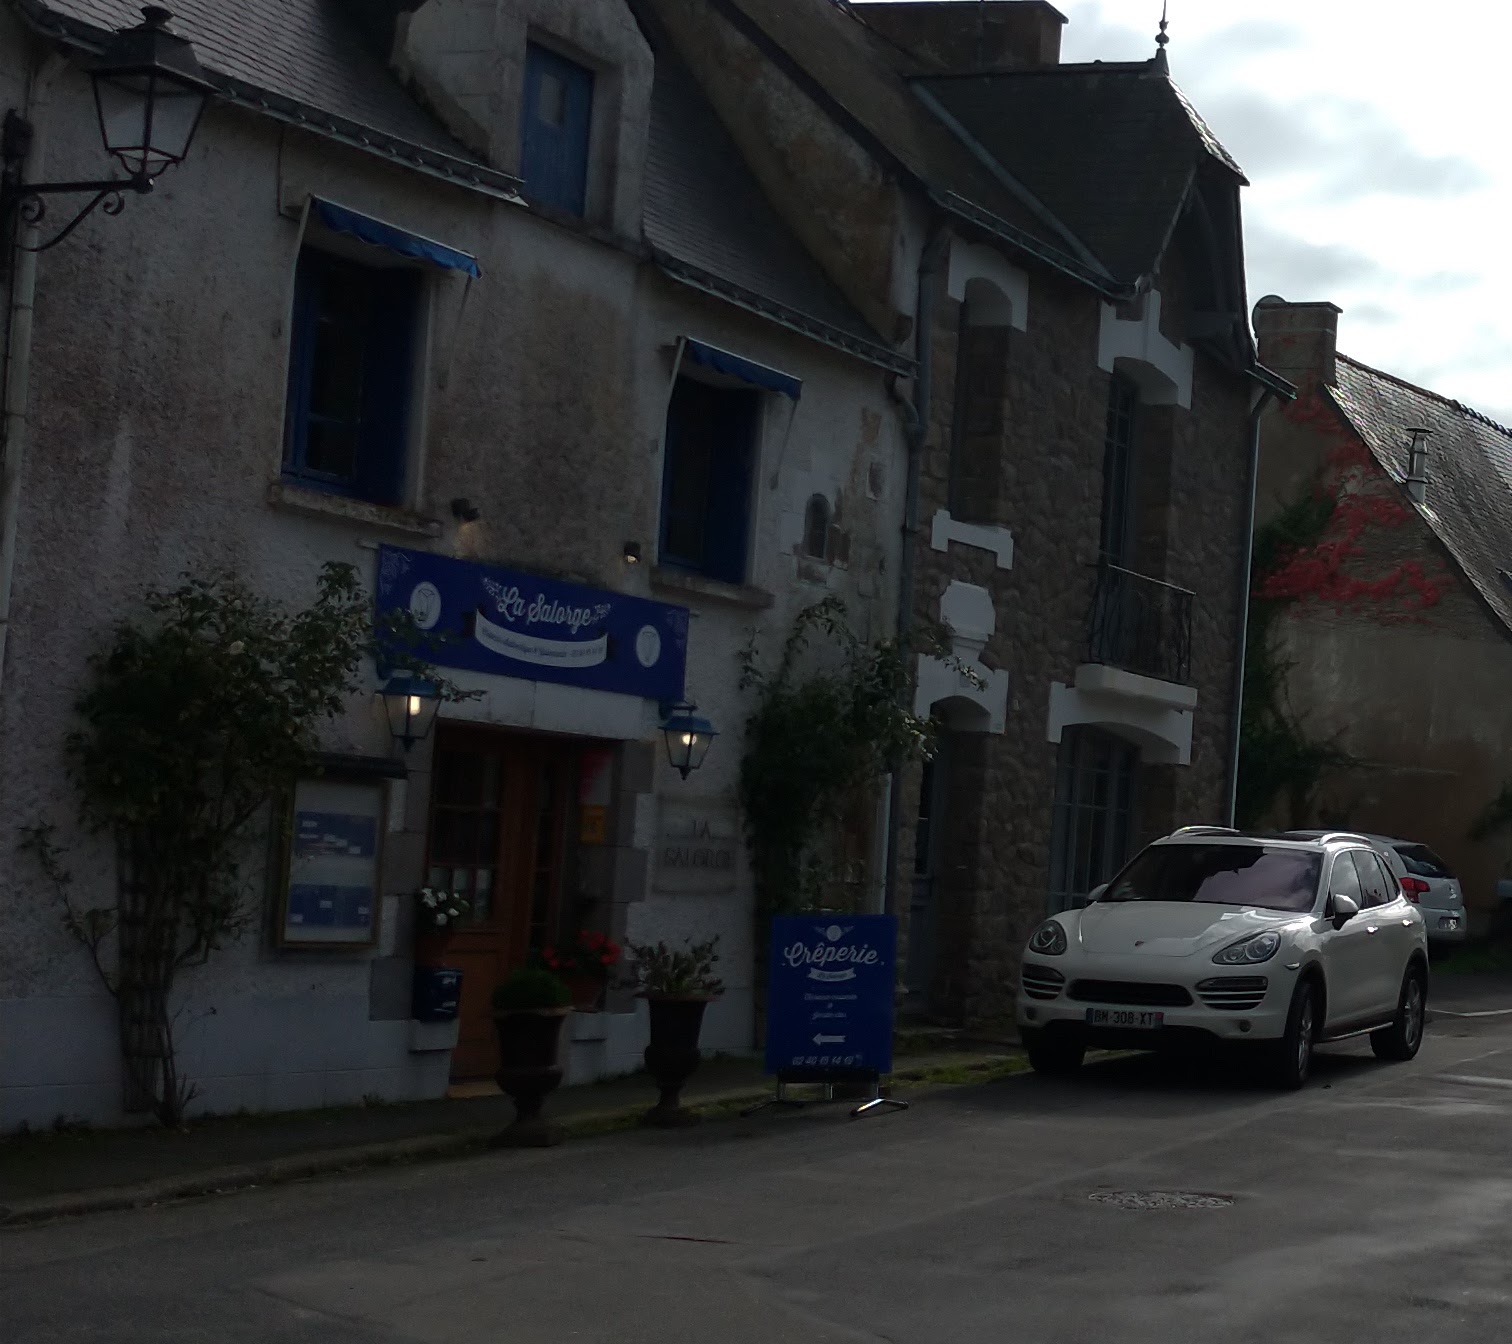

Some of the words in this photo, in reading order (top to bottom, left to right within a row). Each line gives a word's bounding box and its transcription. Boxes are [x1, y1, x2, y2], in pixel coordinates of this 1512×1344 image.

[497, 587, 526, 622] La
[527, 593, 591, 634] Salorge
[784, 942, 879, 967] Crêperie
